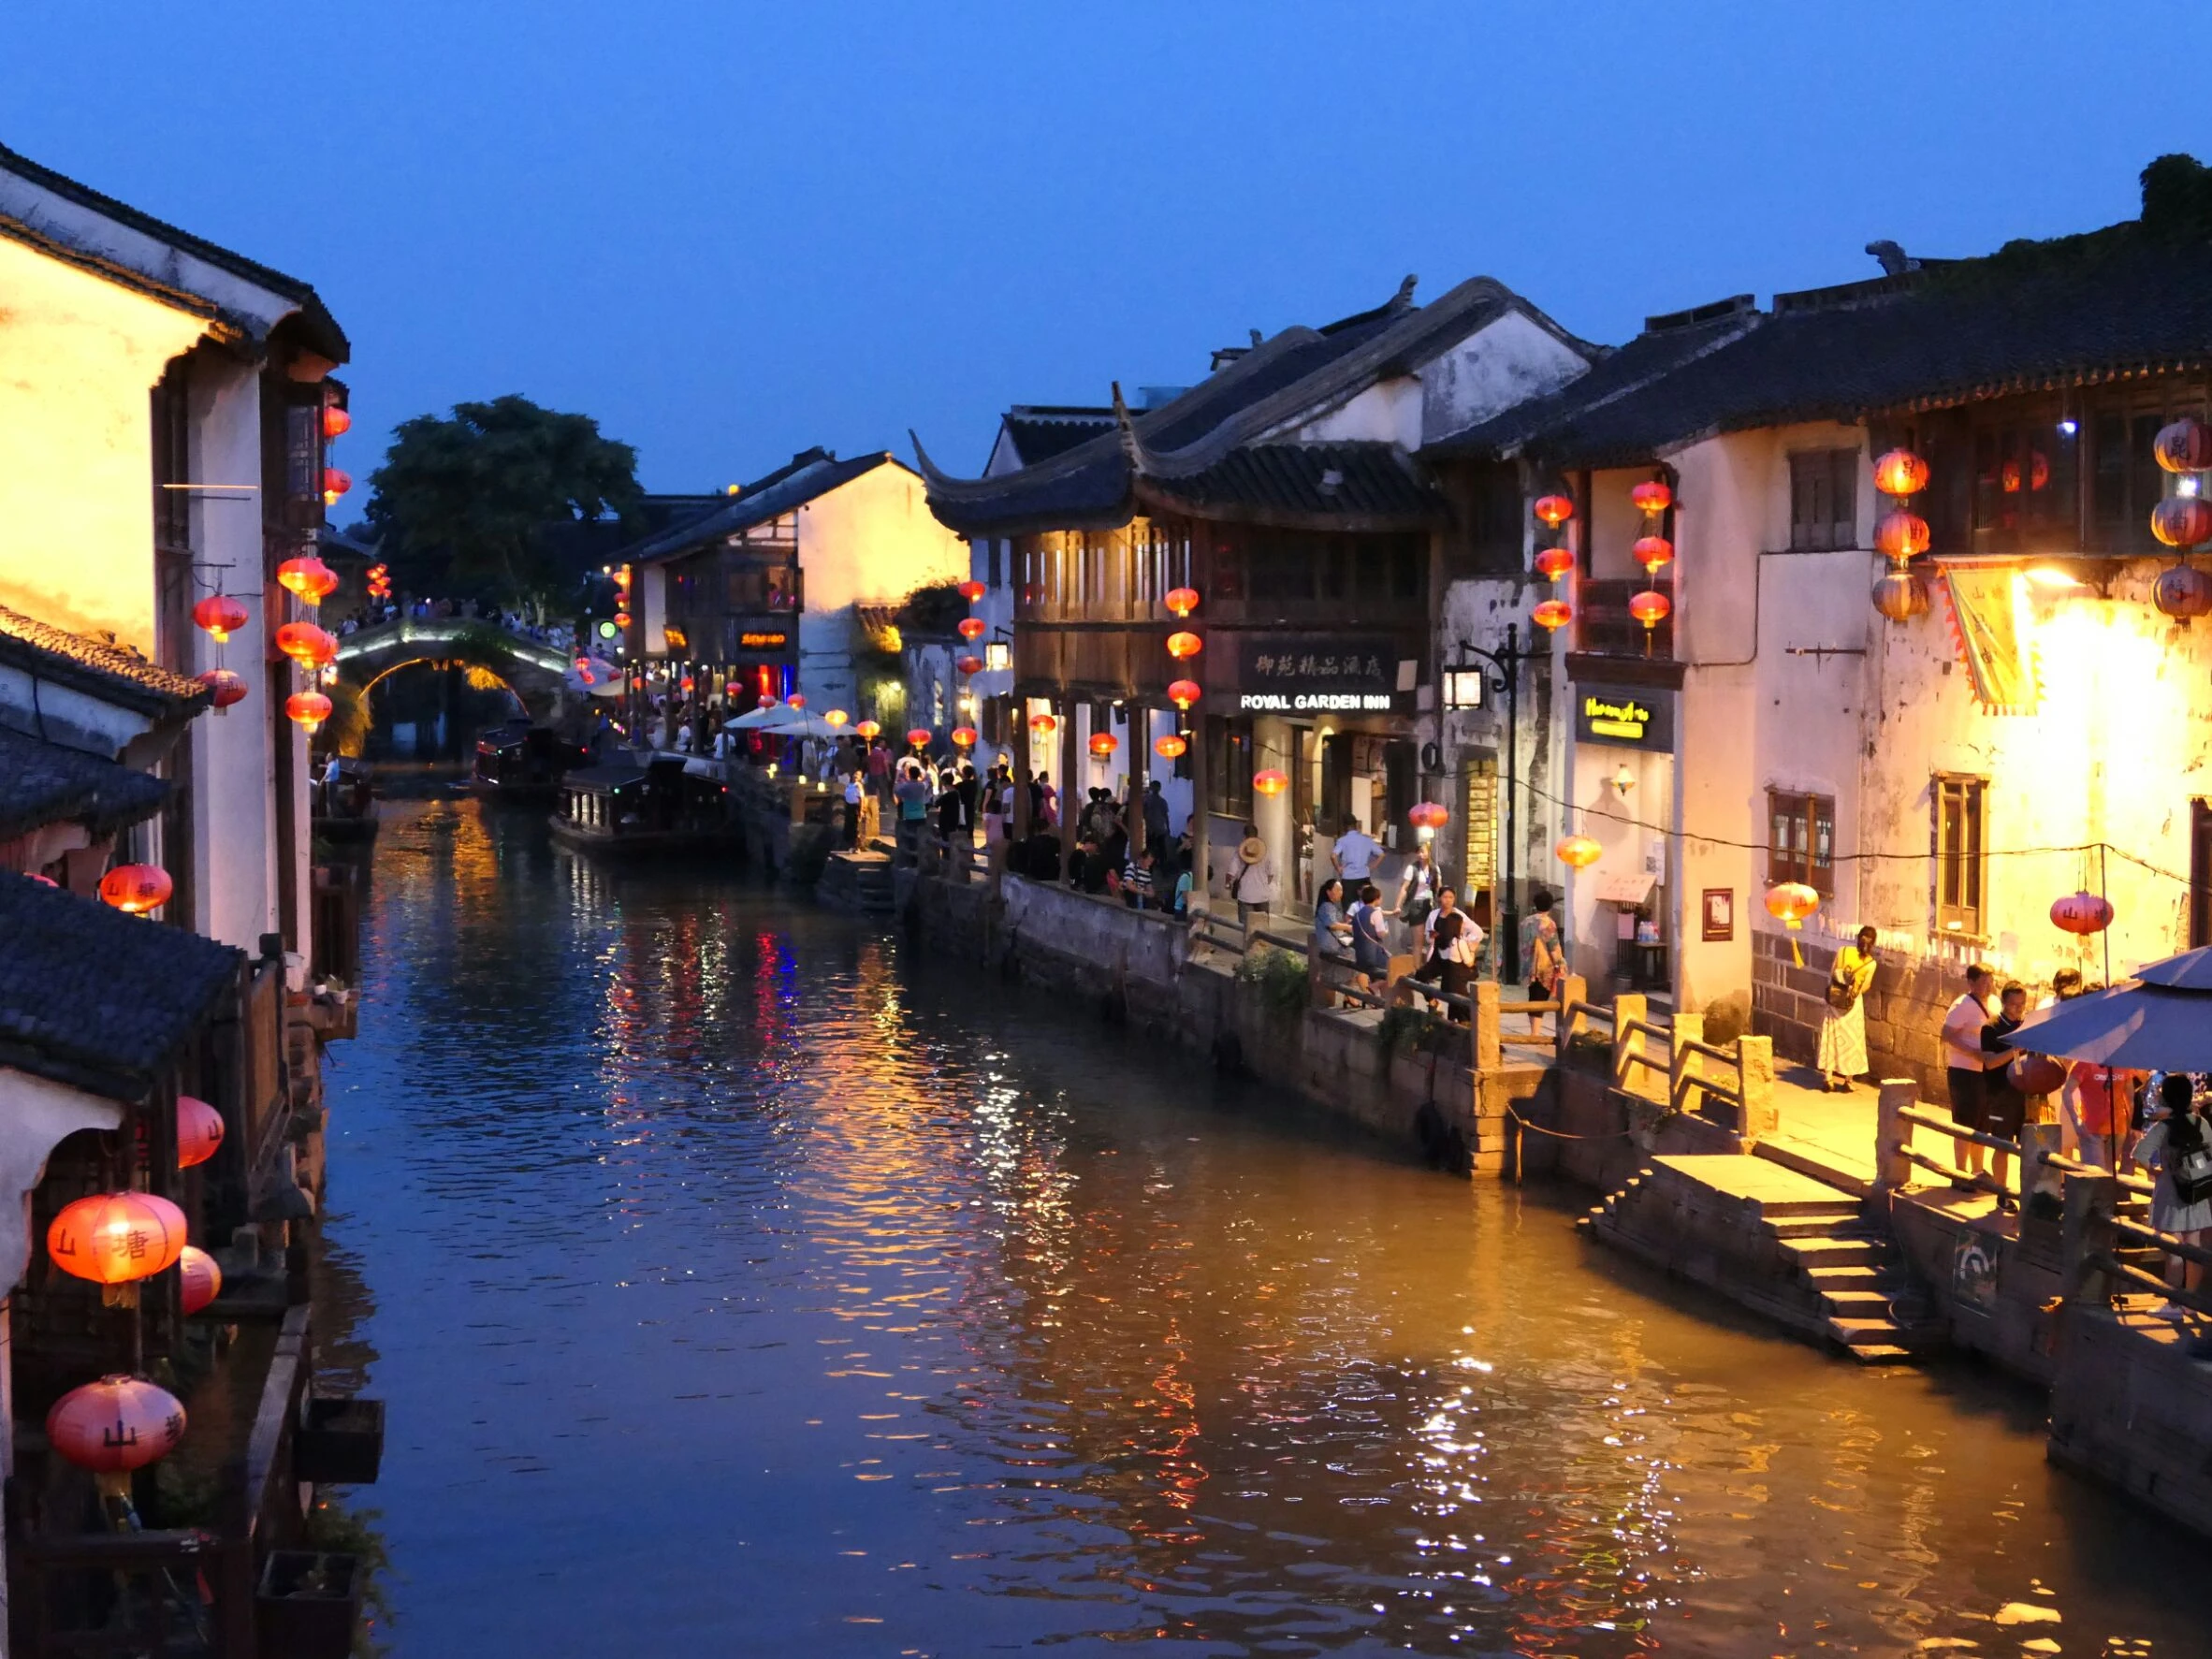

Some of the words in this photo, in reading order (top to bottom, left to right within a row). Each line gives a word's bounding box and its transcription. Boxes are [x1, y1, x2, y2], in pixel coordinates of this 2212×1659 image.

[1241, 694, 1291, 709] ROYAL
[1294, 694, 1361, 709] GARDEN
[1363, 694, 1390, 709] INN
[2062, 906, 2078, 921] 山
[55, 1227, 78, 1257] 山
[111, 1230, 151, 1260] 塘
[104, 1419, 137, 1447] 山
